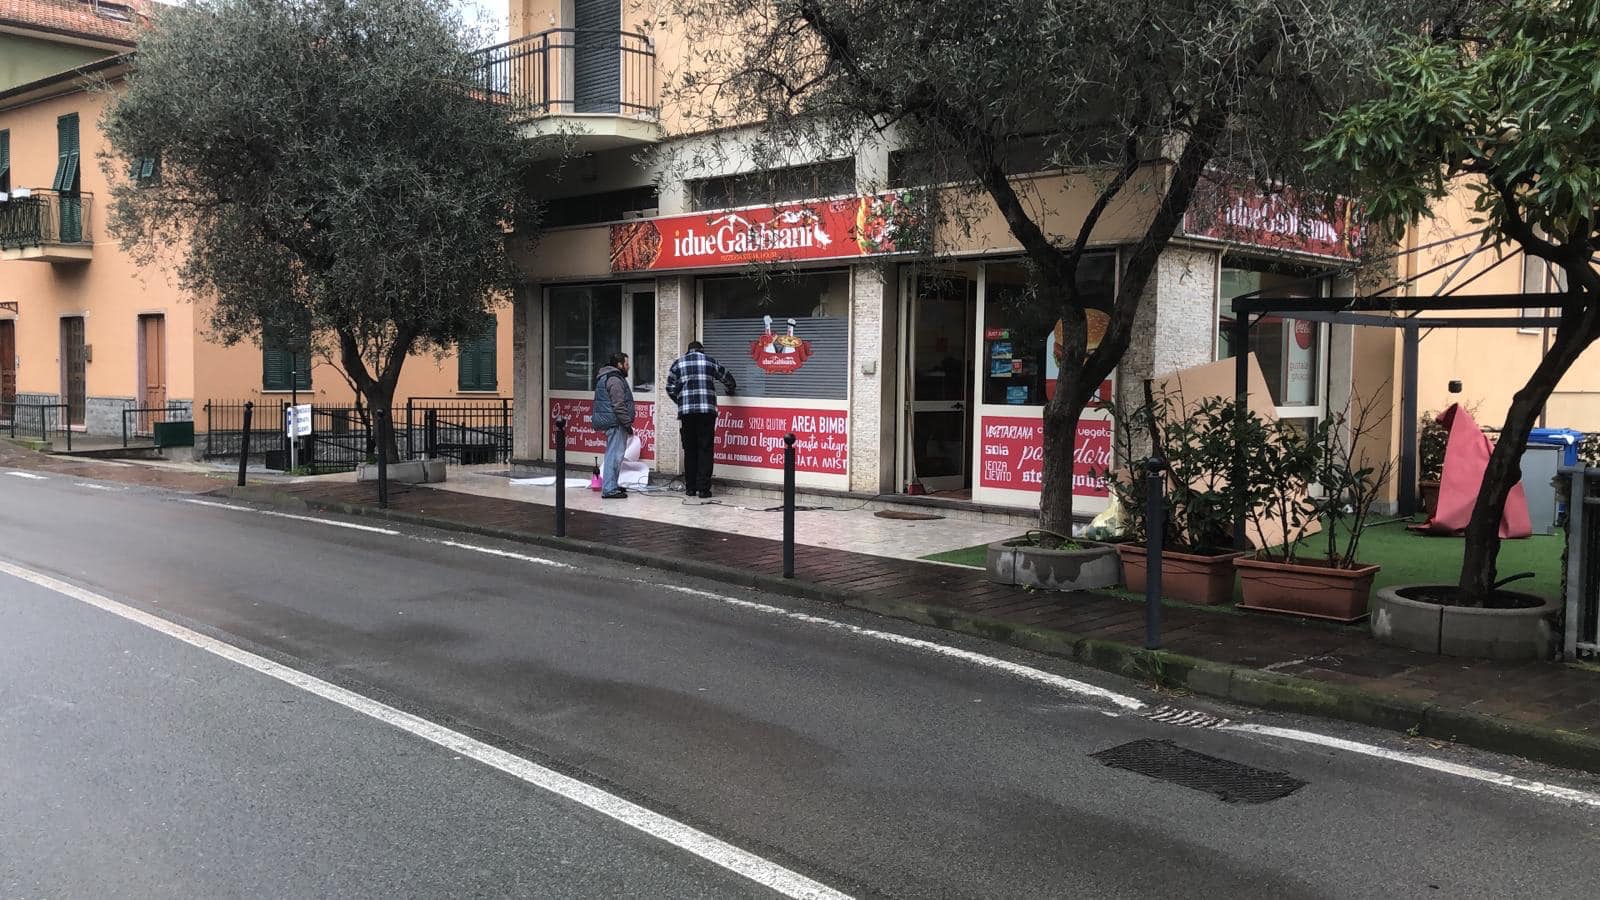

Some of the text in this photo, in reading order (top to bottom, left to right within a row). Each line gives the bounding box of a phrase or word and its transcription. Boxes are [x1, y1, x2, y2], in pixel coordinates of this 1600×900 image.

[749, 417, 764, 430] SENZA
[766, 418, 787, 431] GLUTINE
[791, 416, 816, 433] AREA
[985, 424, 1033, 440] VEGETARIANA
[723, 430, 748, 449] forno
[751, 436, 757, 447] a
[759, 432, 785, 452] legna
[727, 453, 733, 461] AL
[734, 454, 763, 463] FORMAGGIO
[1017, 438, 1110, 470] podor
[985, 461, 1007, 472] SENZA
[984, 470, 1012, 482] LIEVITO
[1022, 469, 1042, 483] ste
